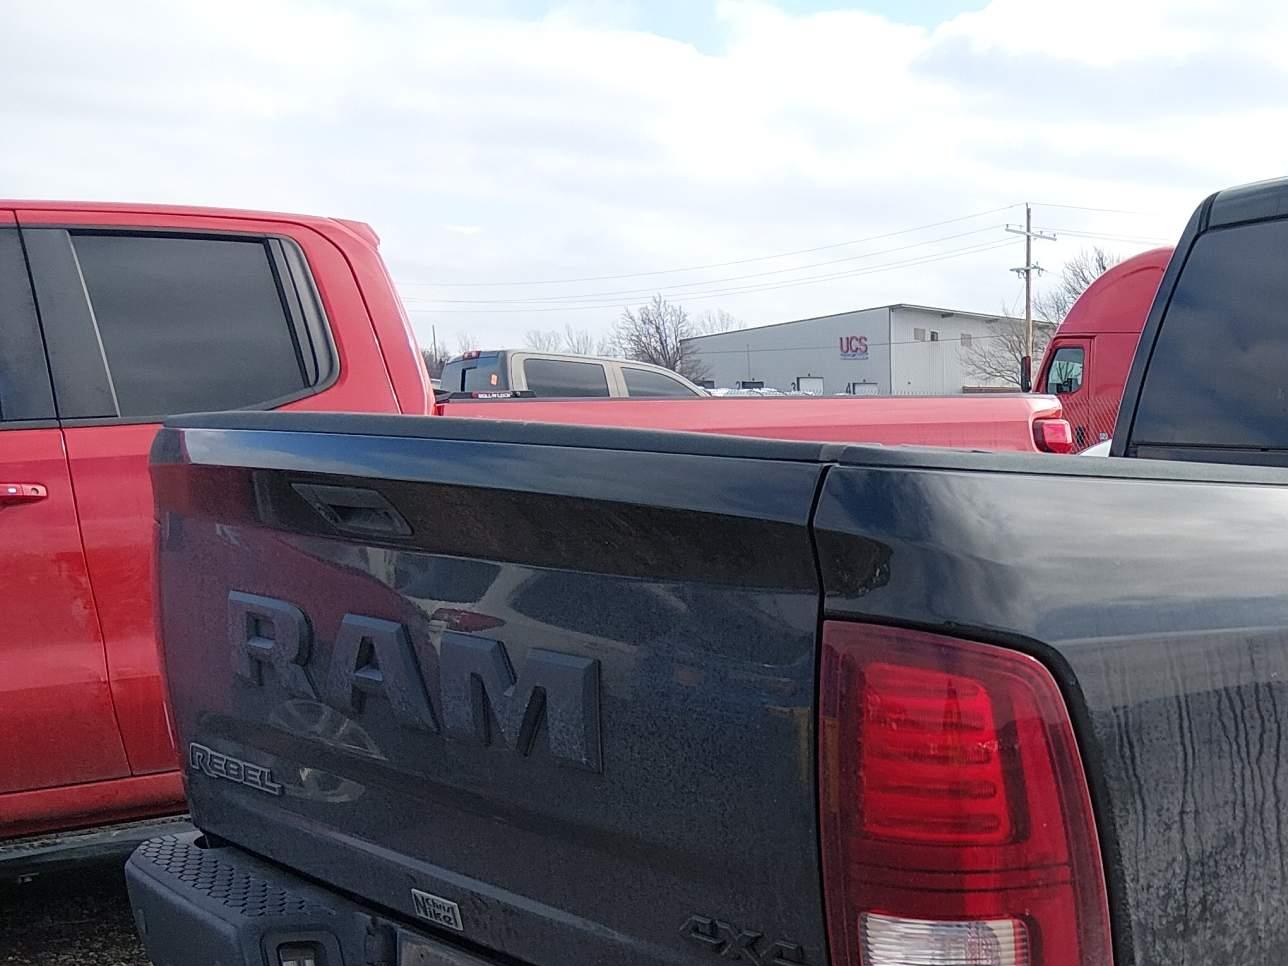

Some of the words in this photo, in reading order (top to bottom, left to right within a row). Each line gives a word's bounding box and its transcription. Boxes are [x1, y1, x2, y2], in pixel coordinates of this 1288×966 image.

[840, 336, 868, 353] UCS
[845, 383, 852, 395] 4
[227, 589, 604, 776] RAM
[188, 742, 283, 796] REBEL
